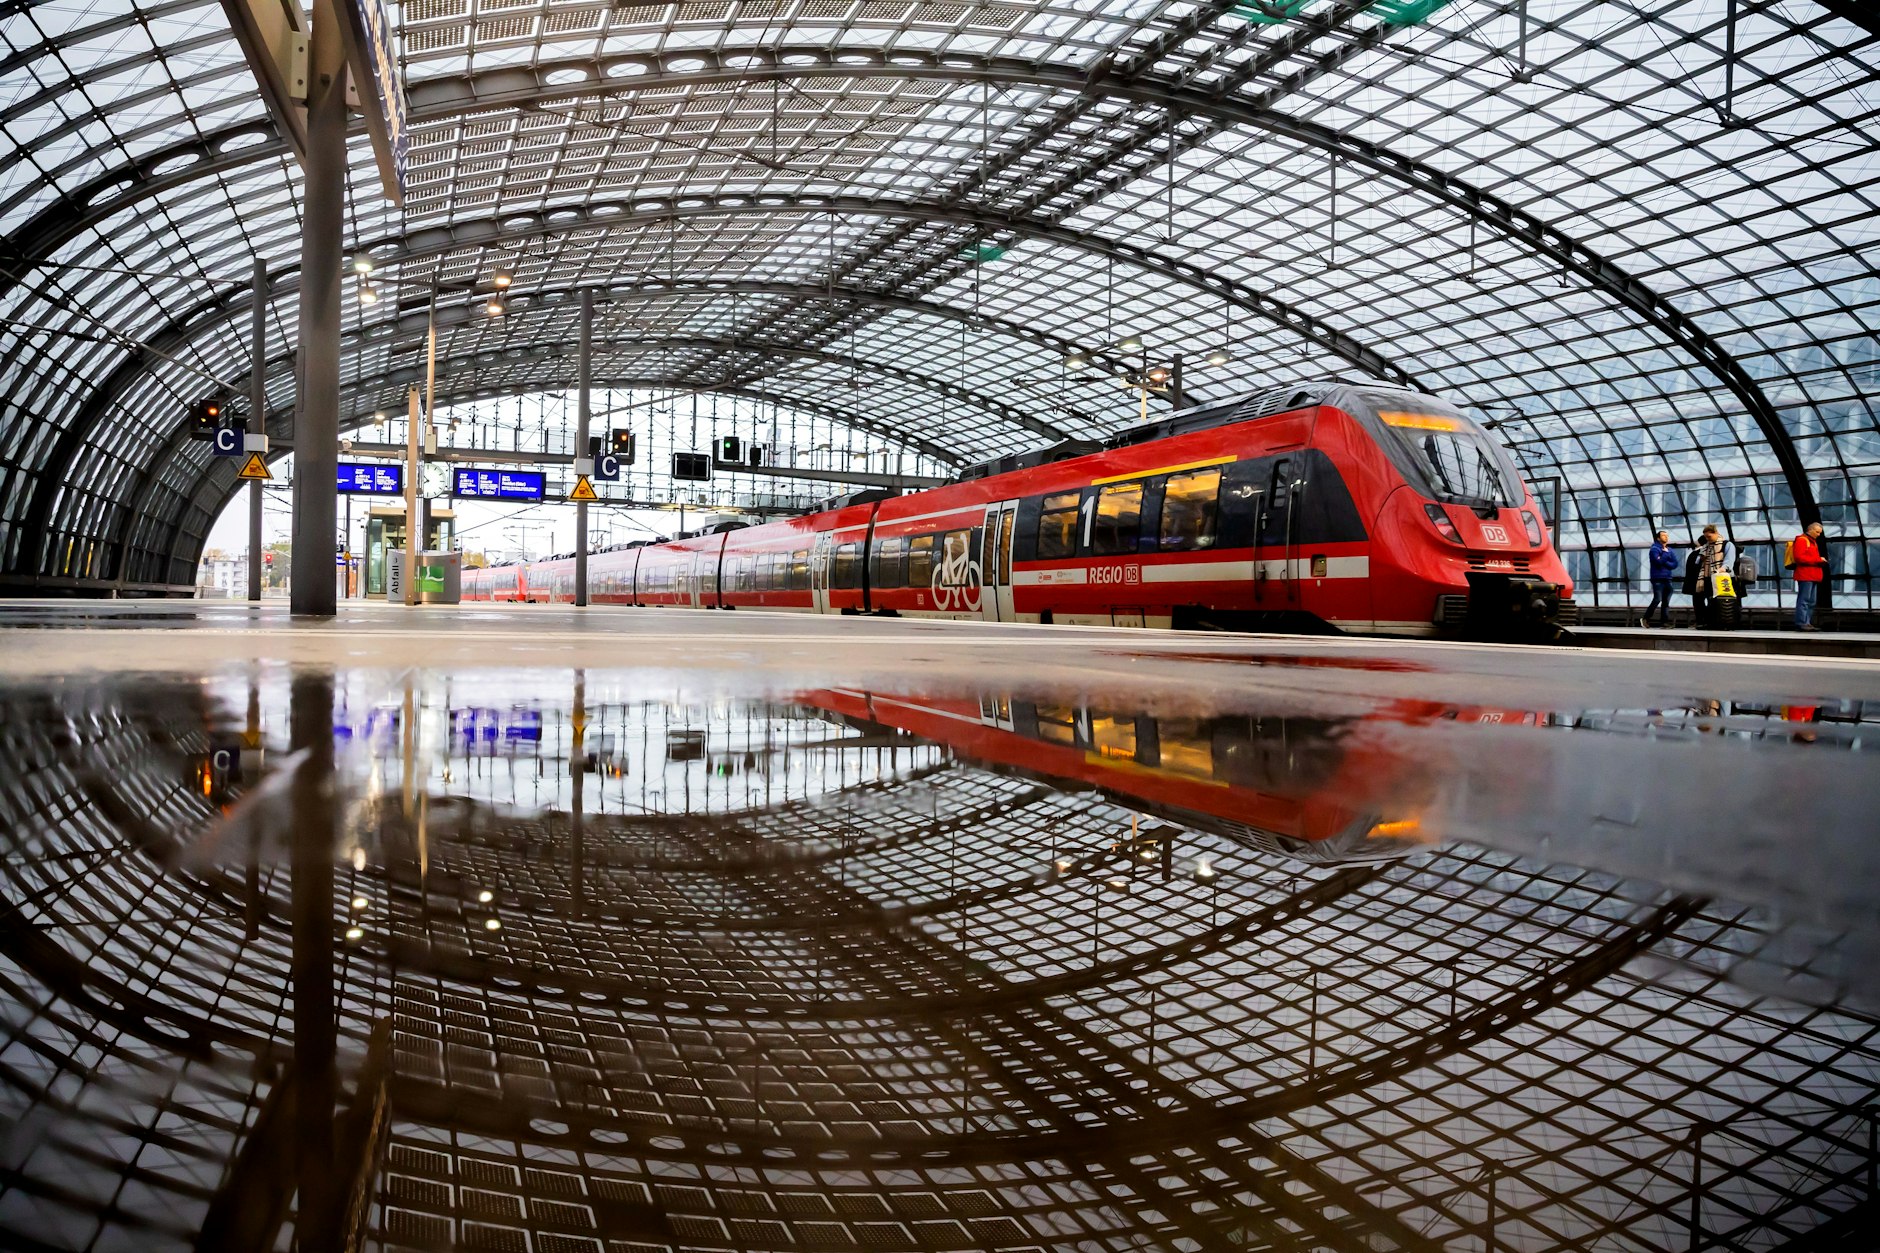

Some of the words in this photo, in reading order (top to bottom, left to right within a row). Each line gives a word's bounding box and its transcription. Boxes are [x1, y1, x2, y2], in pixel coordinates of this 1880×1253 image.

[217, 429, 235, 451] C
[601, 456, 617, 476] C
[1082, 496, 1095, 547] 1
[1484, 527, 1506, 542] DB
[1089, 565, 1123, 584] REGIO
[1126, 567, 1137, 581] DB
